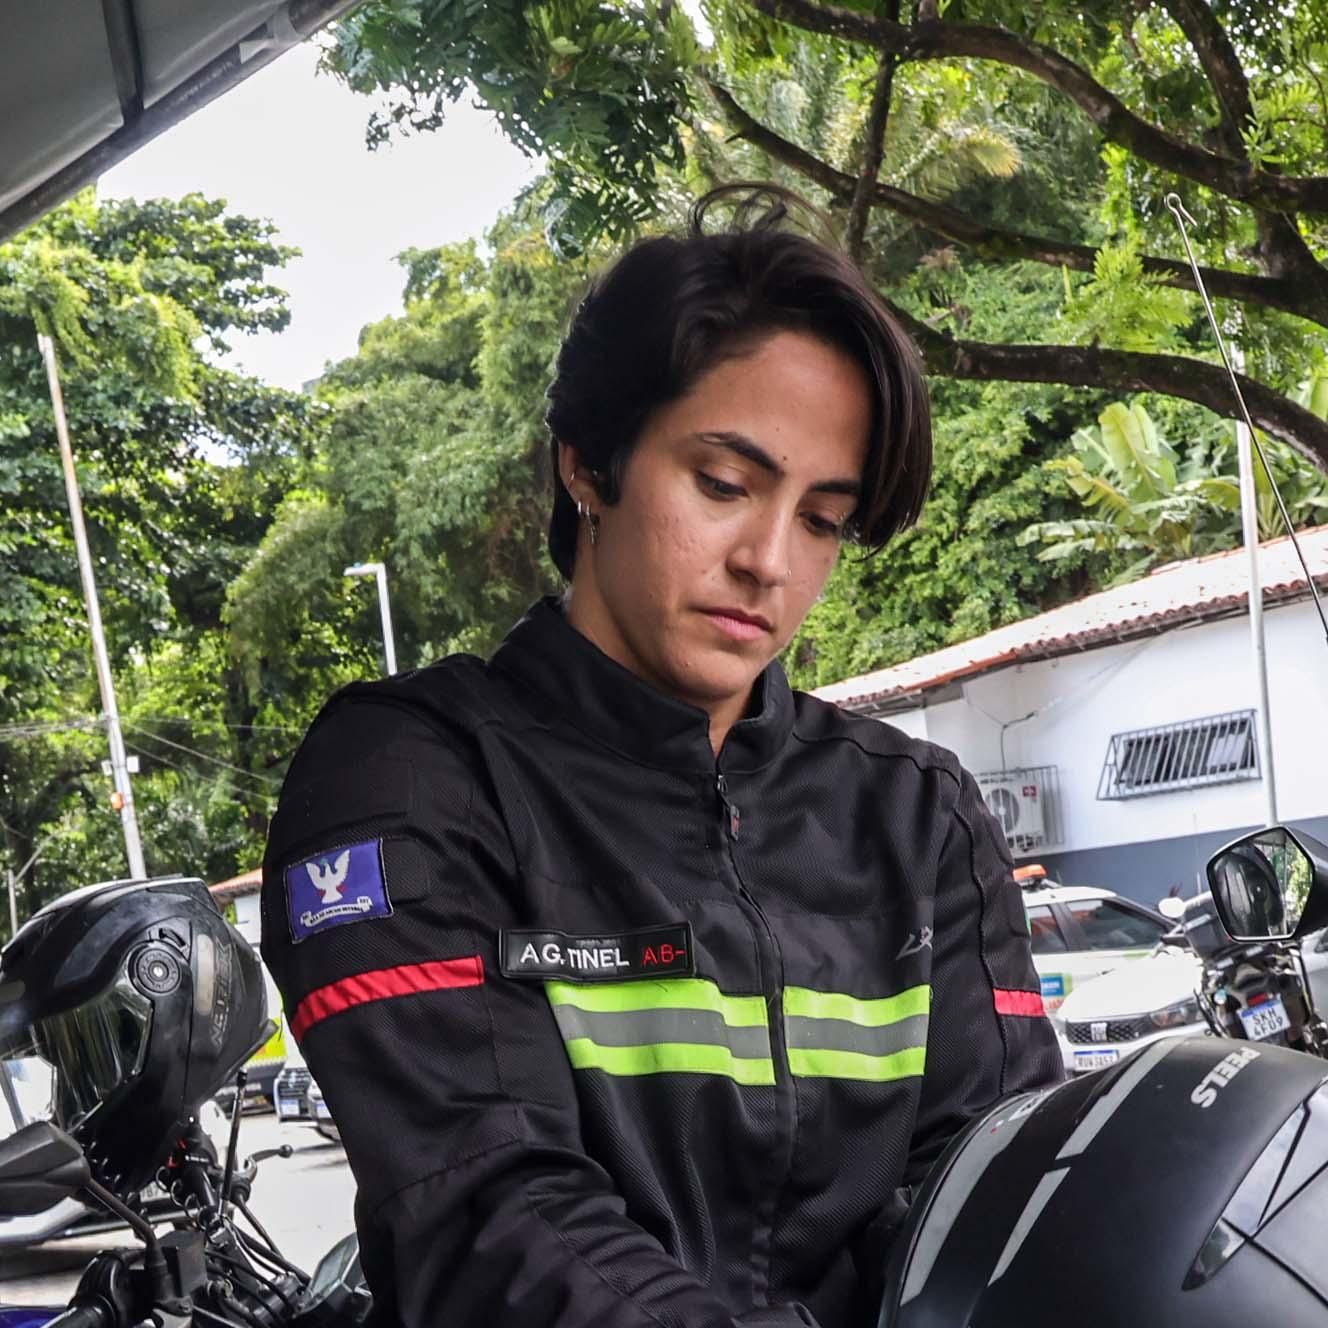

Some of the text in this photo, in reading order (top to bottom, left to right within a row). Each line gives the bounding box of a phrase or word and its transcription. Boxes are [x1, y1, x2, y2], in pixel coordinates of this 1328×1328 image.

[567, 947, 631, 970] TINEL
[641, 943, 687, 967] AB-
[1190, 1046, 1262, 1109] PEELS
